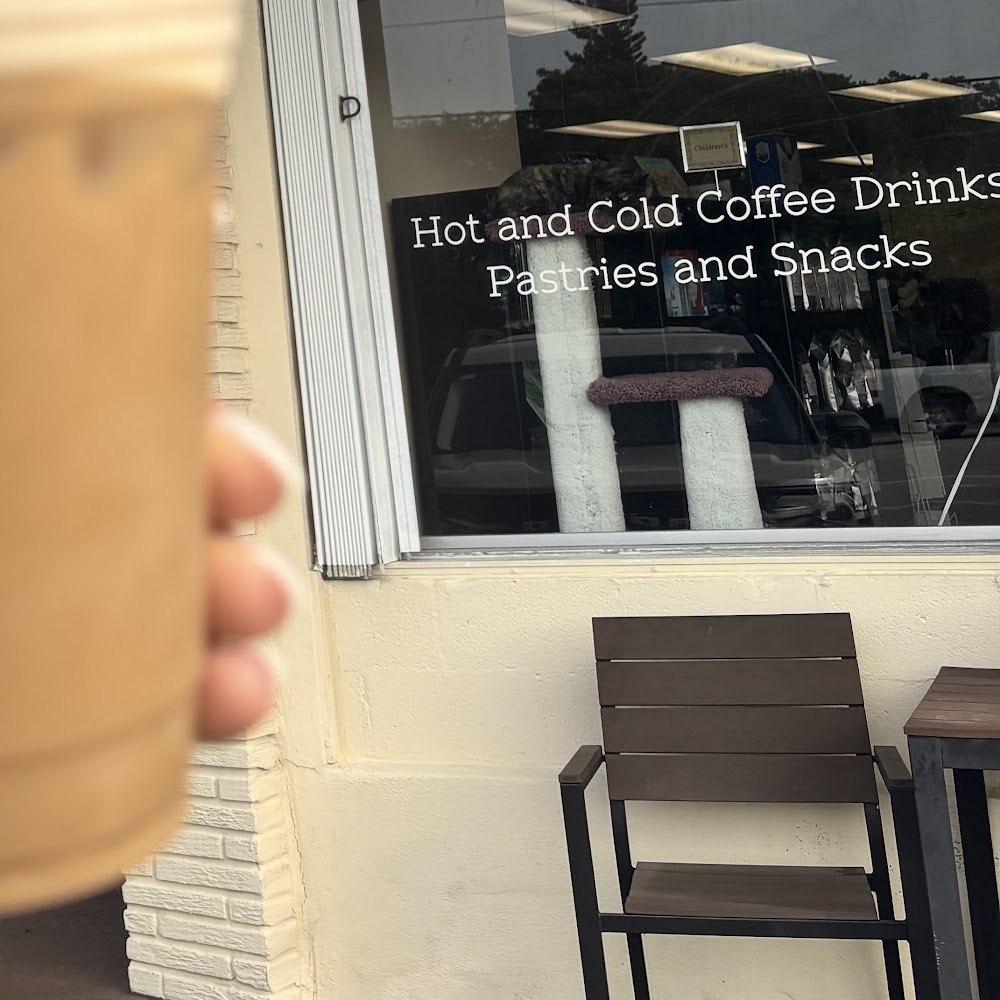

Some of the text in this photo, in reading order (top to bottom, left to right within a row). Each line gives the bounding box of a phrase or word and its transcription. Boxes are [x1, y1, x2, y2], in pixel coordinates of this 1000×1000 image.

[411, 214, 485, 248] Hot
[497, 204, 575, 241] and
[588, 194, 682, 233] Cold
[696, 184, 836, 224] Coffee
[487, 235, 931, 298] Pastries and Snacks
